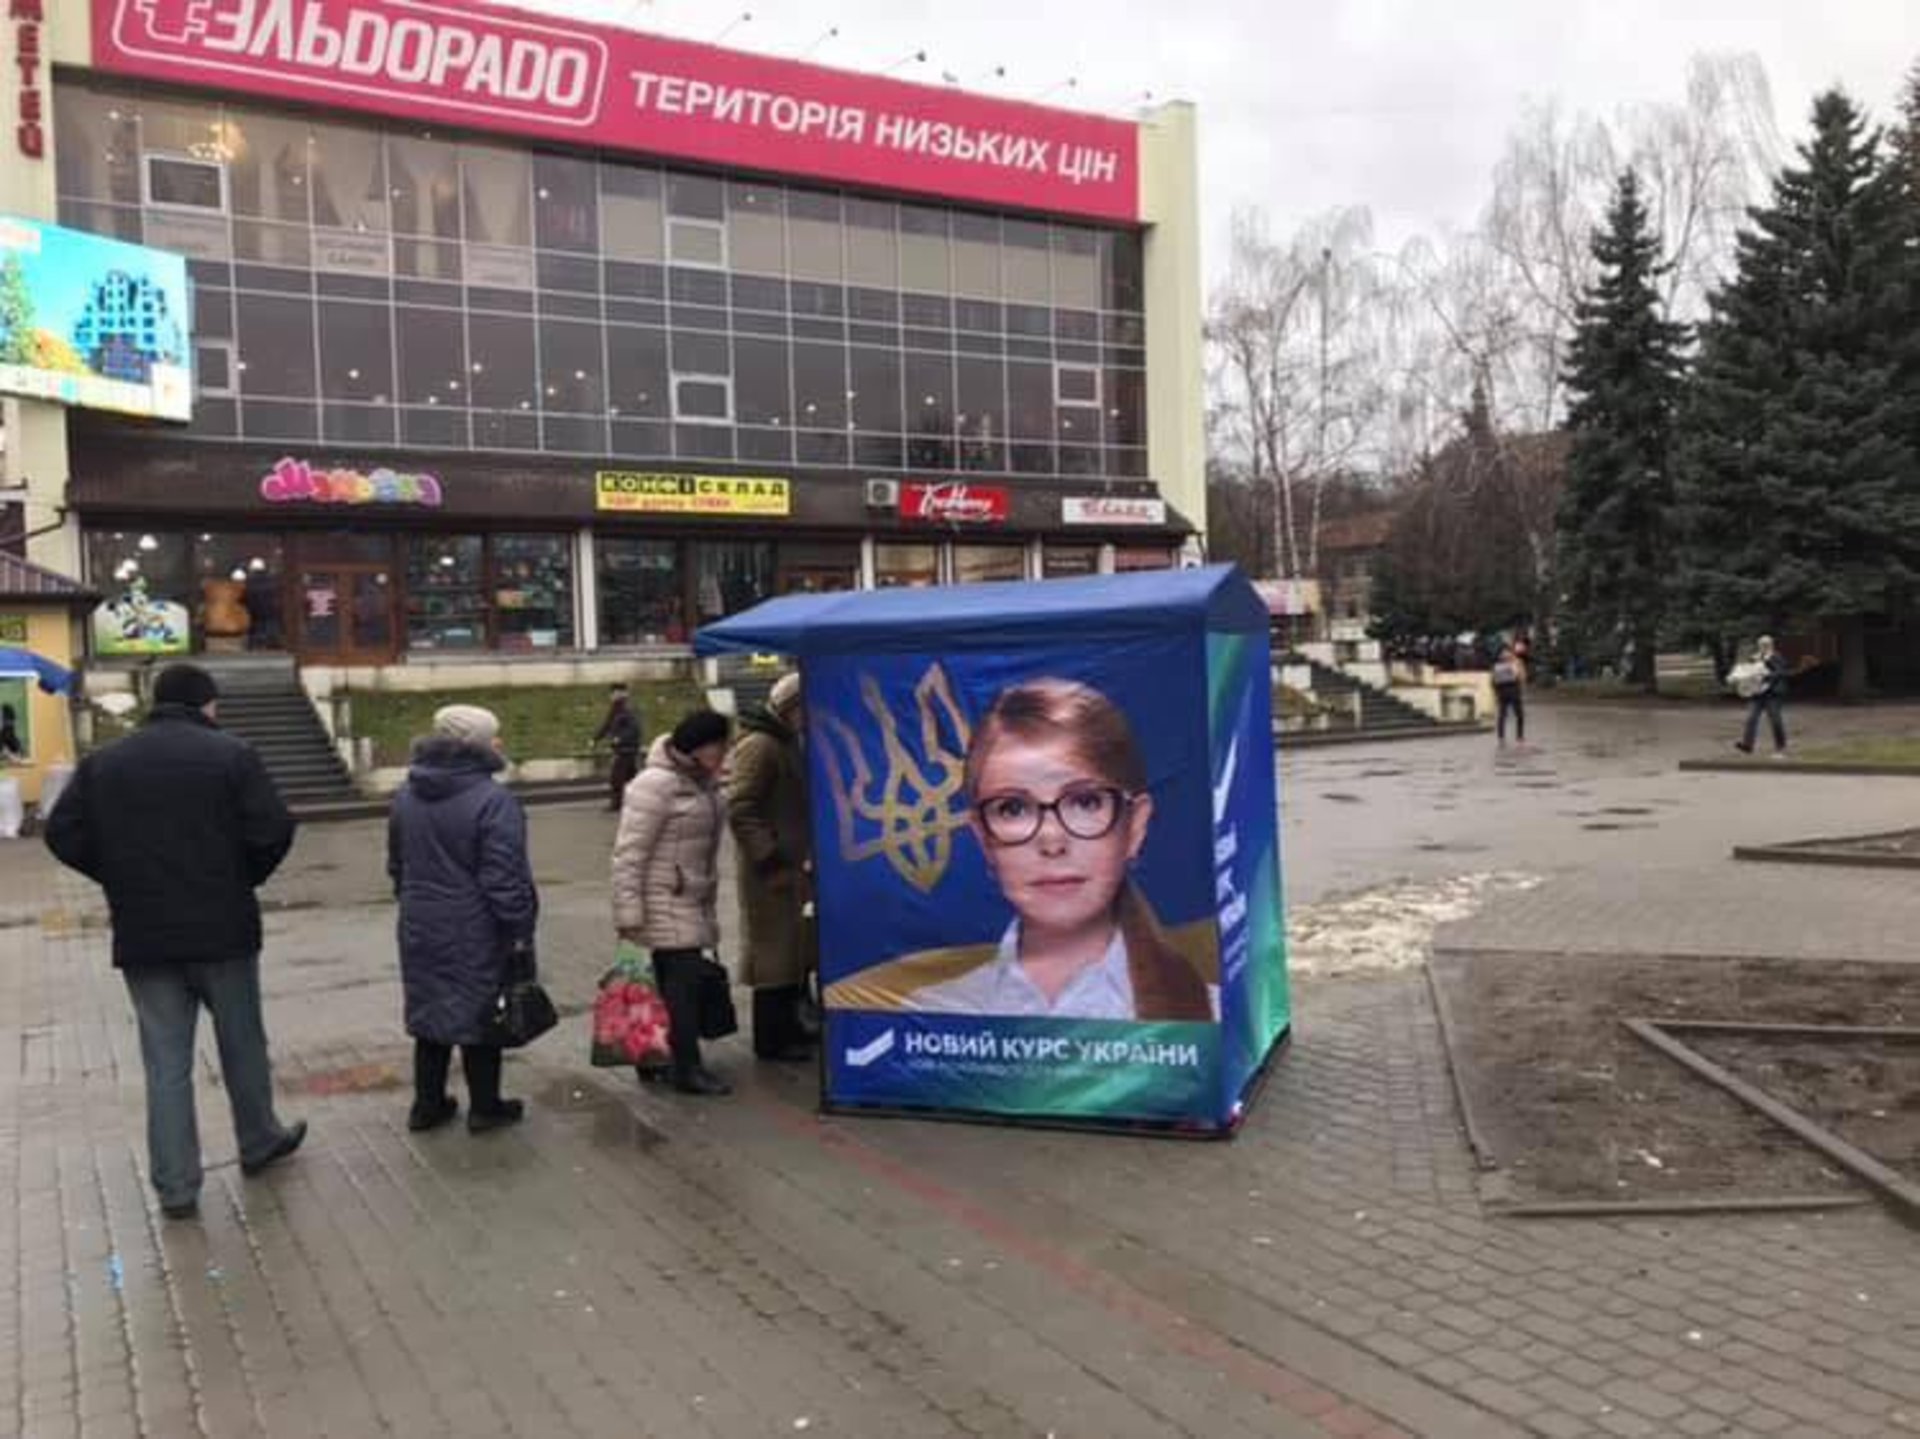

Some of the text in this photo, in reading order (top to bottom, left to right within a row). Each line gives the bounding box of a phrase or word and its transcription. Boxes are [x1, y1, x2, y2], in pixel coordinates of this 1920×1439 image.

[630, 71, 864, 144] ТЕРИТОРІЯ
[874, 112, 1048, 172] НИЗЬКИХ
[1057, 142, 1118, 184] ЦІН
[905, 1030, 997, 1058] НОВИЙ
[1002, 1037, 1070, 1060] КУРС
[1076, 1038, 1199, 1067] УКРАЇНИ
